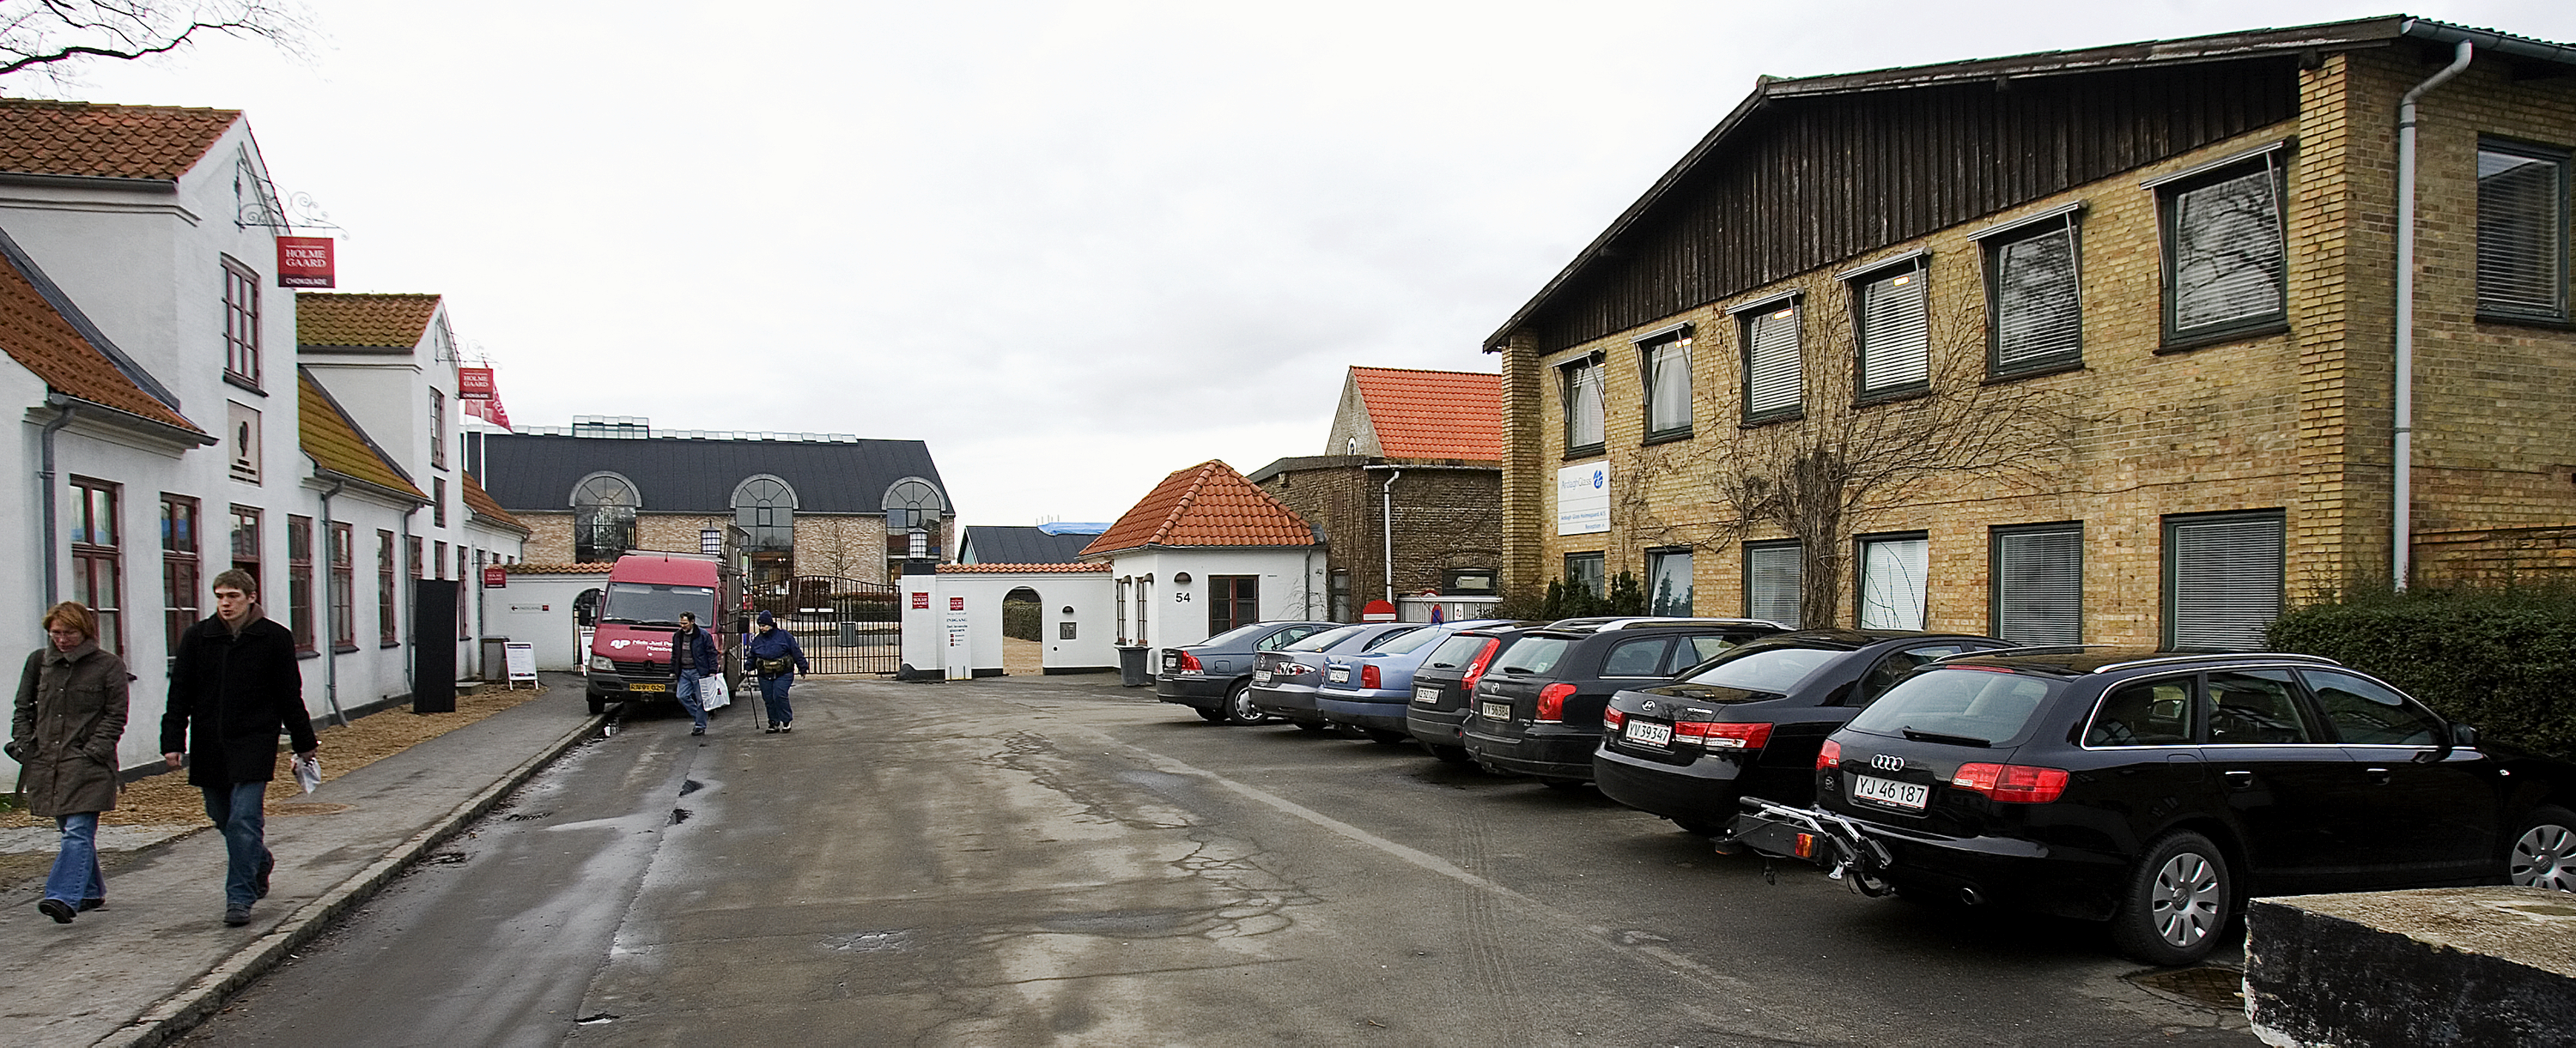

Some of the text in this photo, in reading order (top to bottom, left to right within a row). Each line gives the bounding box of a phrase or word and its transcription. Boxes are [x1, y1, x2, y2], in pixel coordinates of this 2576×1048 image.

[285, 249, 325, 258] HOLME
[285, 258, 326, 268] GAARD
[1176, 592, 1191, 603] 54
[1860, 778, 1876, 795] YJ
[1879, 781, 1896, 799] 46
[1900, 784, 1925, 803] 187
